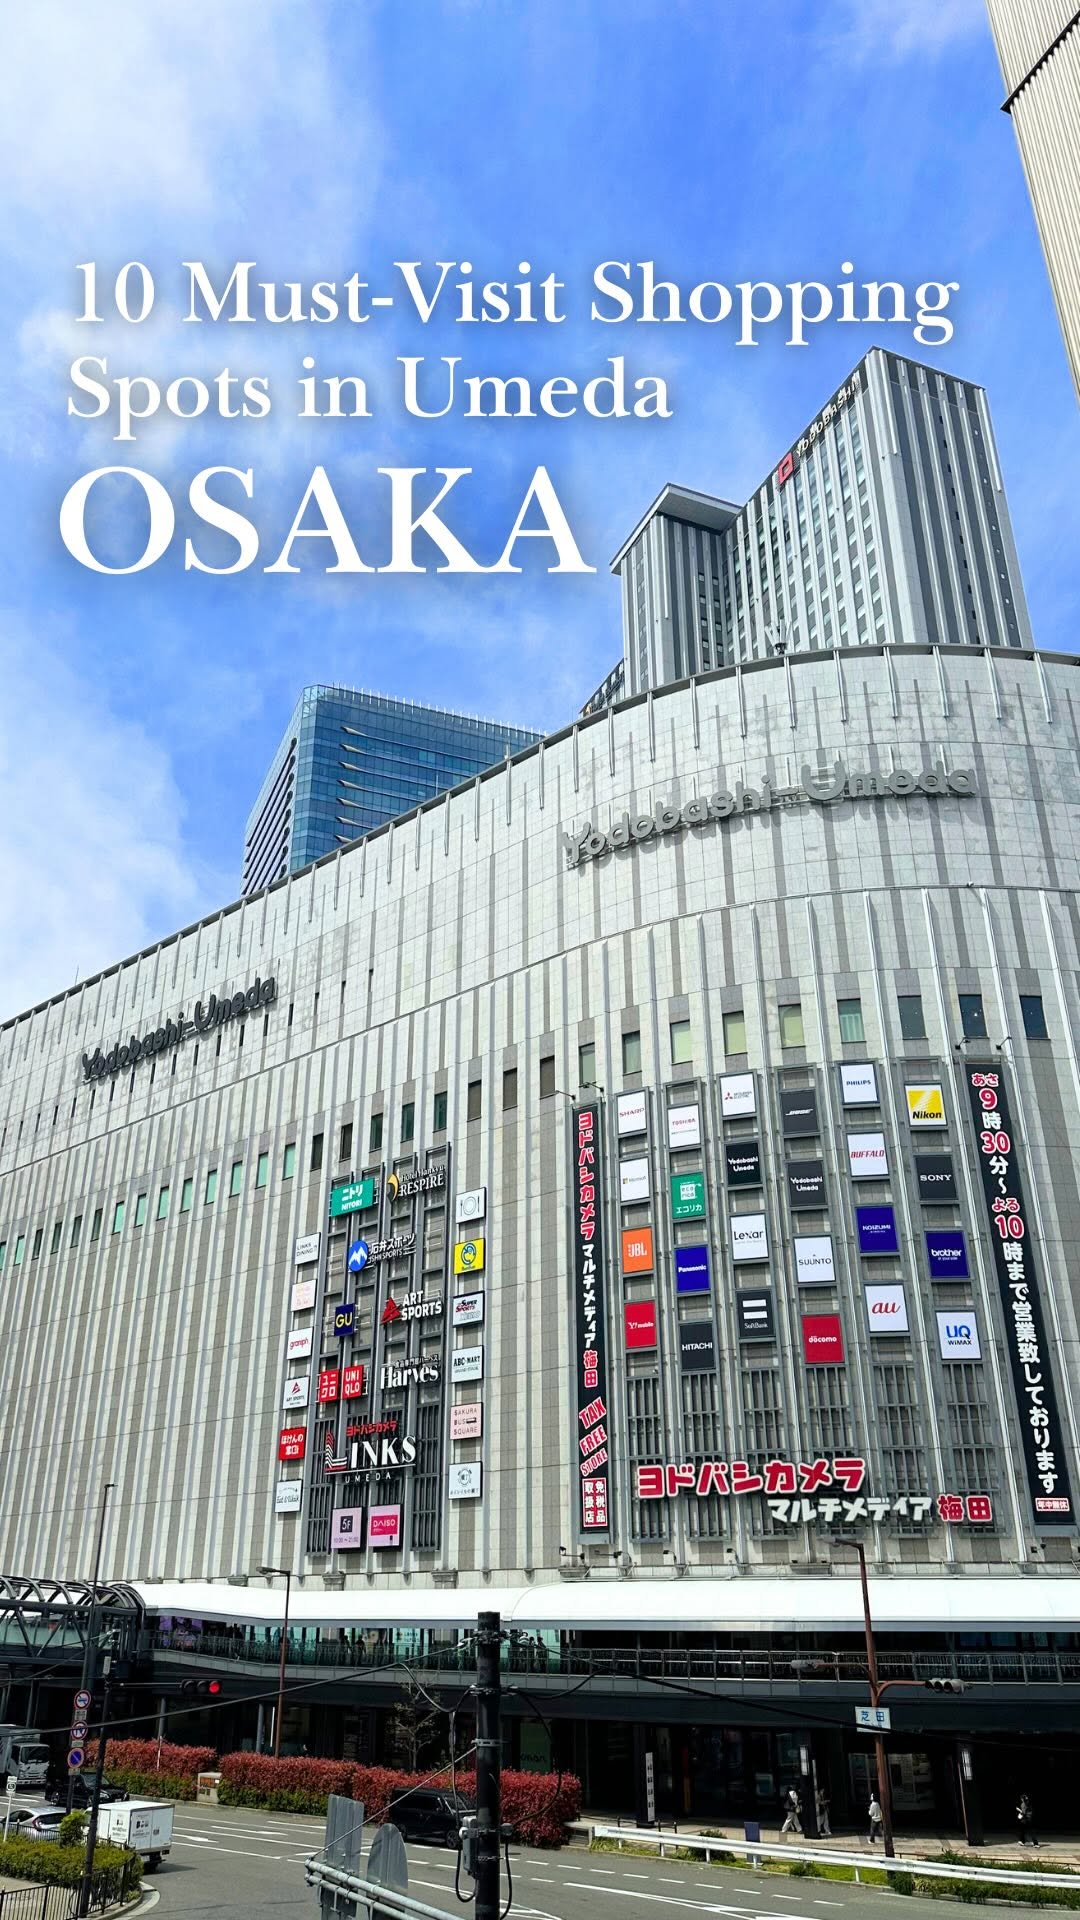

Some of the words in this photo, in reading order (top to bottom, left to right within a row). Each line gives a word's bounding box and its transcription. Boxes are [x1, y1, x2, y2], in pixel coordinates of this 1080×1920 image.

[563, 761, 976, 864] Yodobashi-Umeda
[82, 977, 275, 1080] Yodobashi-Umeda
[619, 1107, 645, 1117] SHARP
[912, 1110, 942, 1120] Nikon
[672, 1118, 696, 1126] TOSHIBA
[850, 1149, 885, 1159] BUFFALO
[728, 1156, 758, 1165] Yodobashi
[791, 1176, 822, 1185] Yodobashi
[920, 1174, 951, 1182] SONY
[398, 1173, 444, 1197] RESPIRE
[796, 1184, 818, 1192] Umeda
[341, 1184, 363, 1202] ニトリ
[341, 1199, 363, 1211] NITORI
[676, 1204, 702, 1214] エコリカ
[734, 1230, 764, 1241] Lexar
[370, 1232, 415, 1255] 石井スポーツ
[628, 1242, 647, 1257] JBL
[382, 1249, 403, 1260] SPORTS
[931, 1248, 961, 1257] brother
[678, 1265, 707, 1273] Panasonic
[402, 1290, 424, 1307] ART
[401, 1300, 443, 1321] SPORTS
[872, 1302, 900, 1314] au
[335, 1312, 353, 1328] GU
[946, 1325, 971, 1339] UQ
[682, 1342, 713, 1350] HITACHI
[321, 1373, 337, 1386] ユニ
[346, 1369, 360, 1381] UNI
[380, 1364, 439, 1390] Harves
[321, 1386, 336, 1398] クロ
[345, 1382, 360, 1395] QLO
[454, 1407, 477, 1416] SAKURA
[578, 1396, 607, 1430] TAX
[454, 1418, 466, 1426] BUS
[345, 1420, 397, 1437] ヨドバシカメラ
[453, 1426, 477, 1436] SQUARE
[281, 1433, 303, 1445] ほけんの
[579, 1424, 608, 1457] FREE
[324, 1430, 416, 1472] LINKS
[580, 1448, 608, 1477] STORE
[344, 1472, 392, 1484] UMEDA
[638, 1458, 865, 1498] ヨドバシカメラ
[341, 1518, 352, 1530] 5F
[373, 1519, 396, 1527] DAISO
[860, 1710, 885, 1722] 芝田
